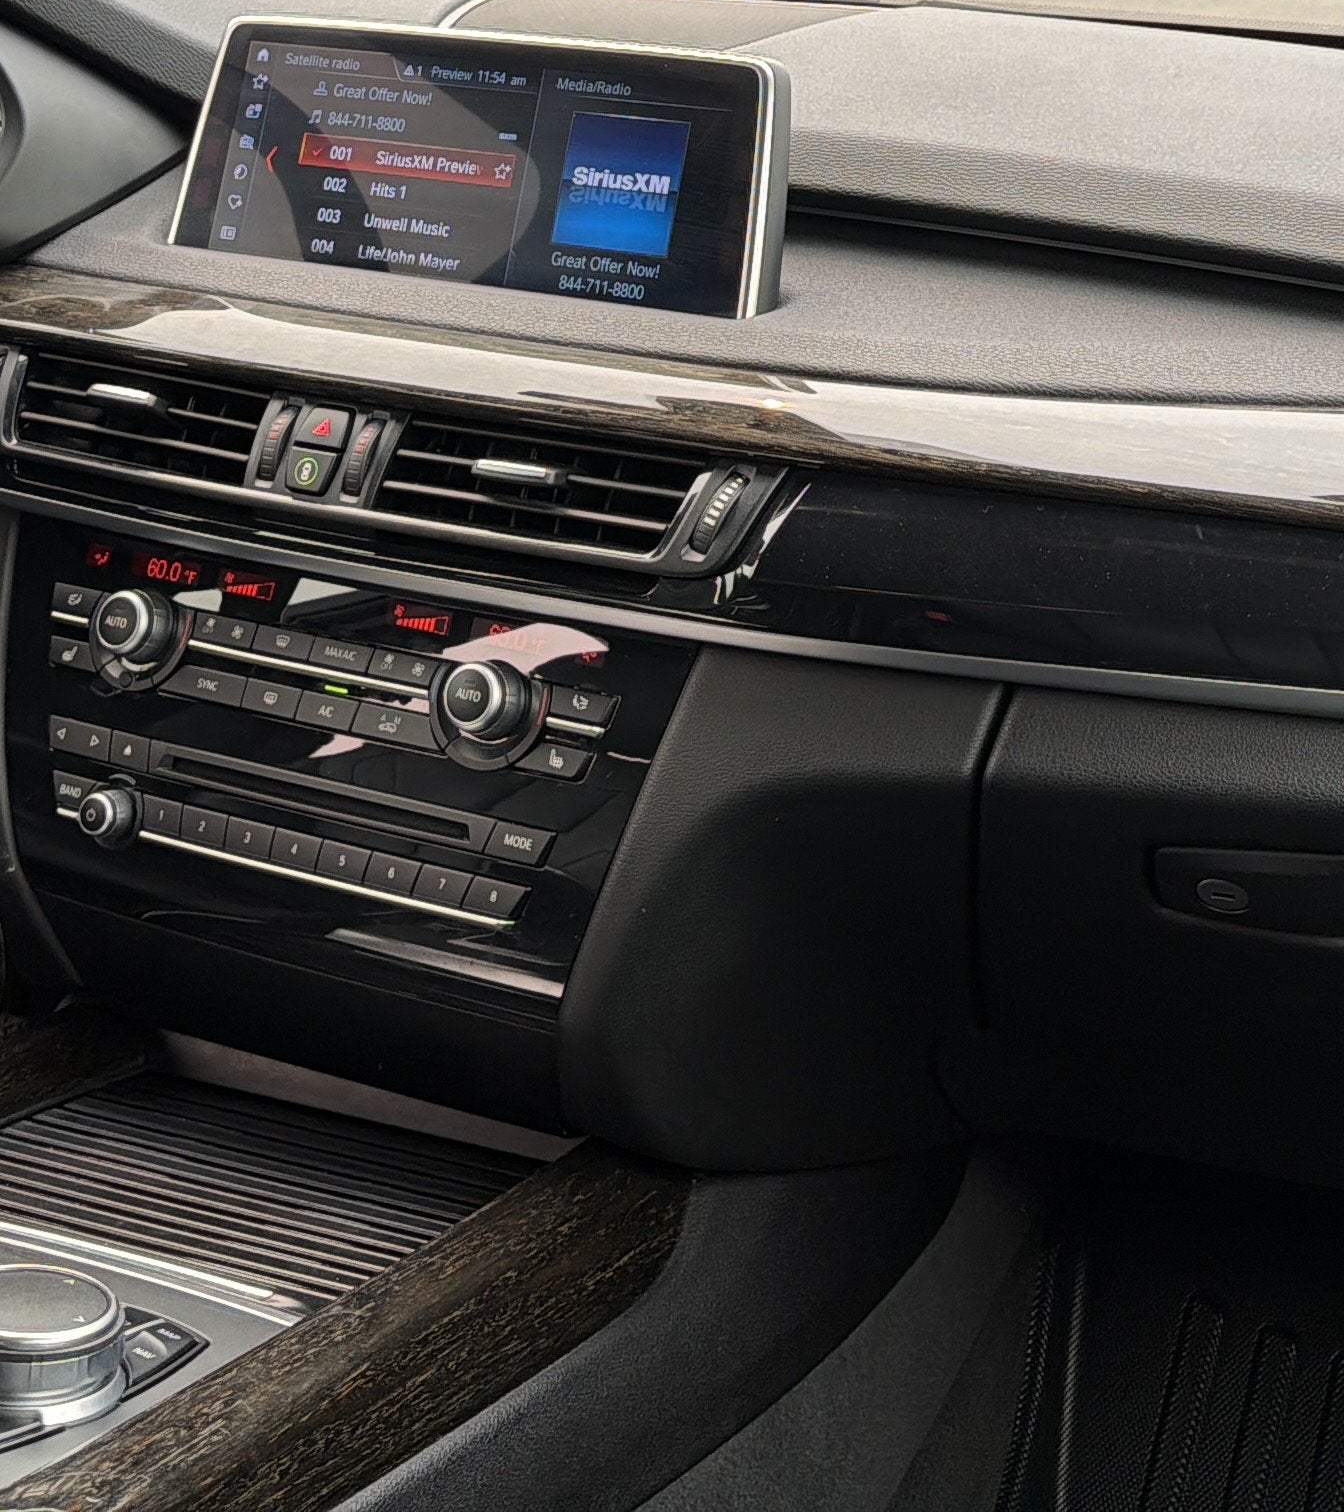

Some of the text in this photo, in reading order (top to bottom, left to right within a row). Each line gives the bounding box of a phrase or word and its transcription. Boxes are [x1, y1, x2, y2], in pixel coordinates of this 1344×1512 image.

[285, 52, 360, 71] Satellite radio
[416, 65, 527, 87] 1 Preview 11:54 am
[333, 85, 432, 106] Great Offer Now!
[556, 78, 632, 96] Media/Radio
[327, 111, 406, 133] 844-711-8800
[329, 145, 353, 162] 001
[375, 149, 433, 172] SiriusXM
[323, 176, 407, 200] 002 Hits 1
[572, 166, 671, 195] SiriusXM
[317, 207, 451, 238] 003 Unwell Music
[311, 238, 461, 272] 004 Life/John Mayer
[551, 251, 661, 279] Great Offer Now!
[559, 275, 645, 300] 844-711-8800
[147, 557, 198, 585] 60.0 °F
[105, 614, 127, 629] AUTO
[197, 677, 219, 692] SYNC
[455, 687, 482, 703] AUTO
[318, 705, 334, 718] A/C
[59, 784, 81, 798] BAND
[158, 809, 165, 821] 1
[198, 821, 206, 832] 2
[244, 832, 252, 844] 3
[503, 833, 534, 852] MODE
[290, 843, 299, 855] 4
[339, 855, 346, 866] 5
[387, 867, 395, 879] 6
[439, 878, 447, 890] 7
[489, 890, 498, 902] 8
